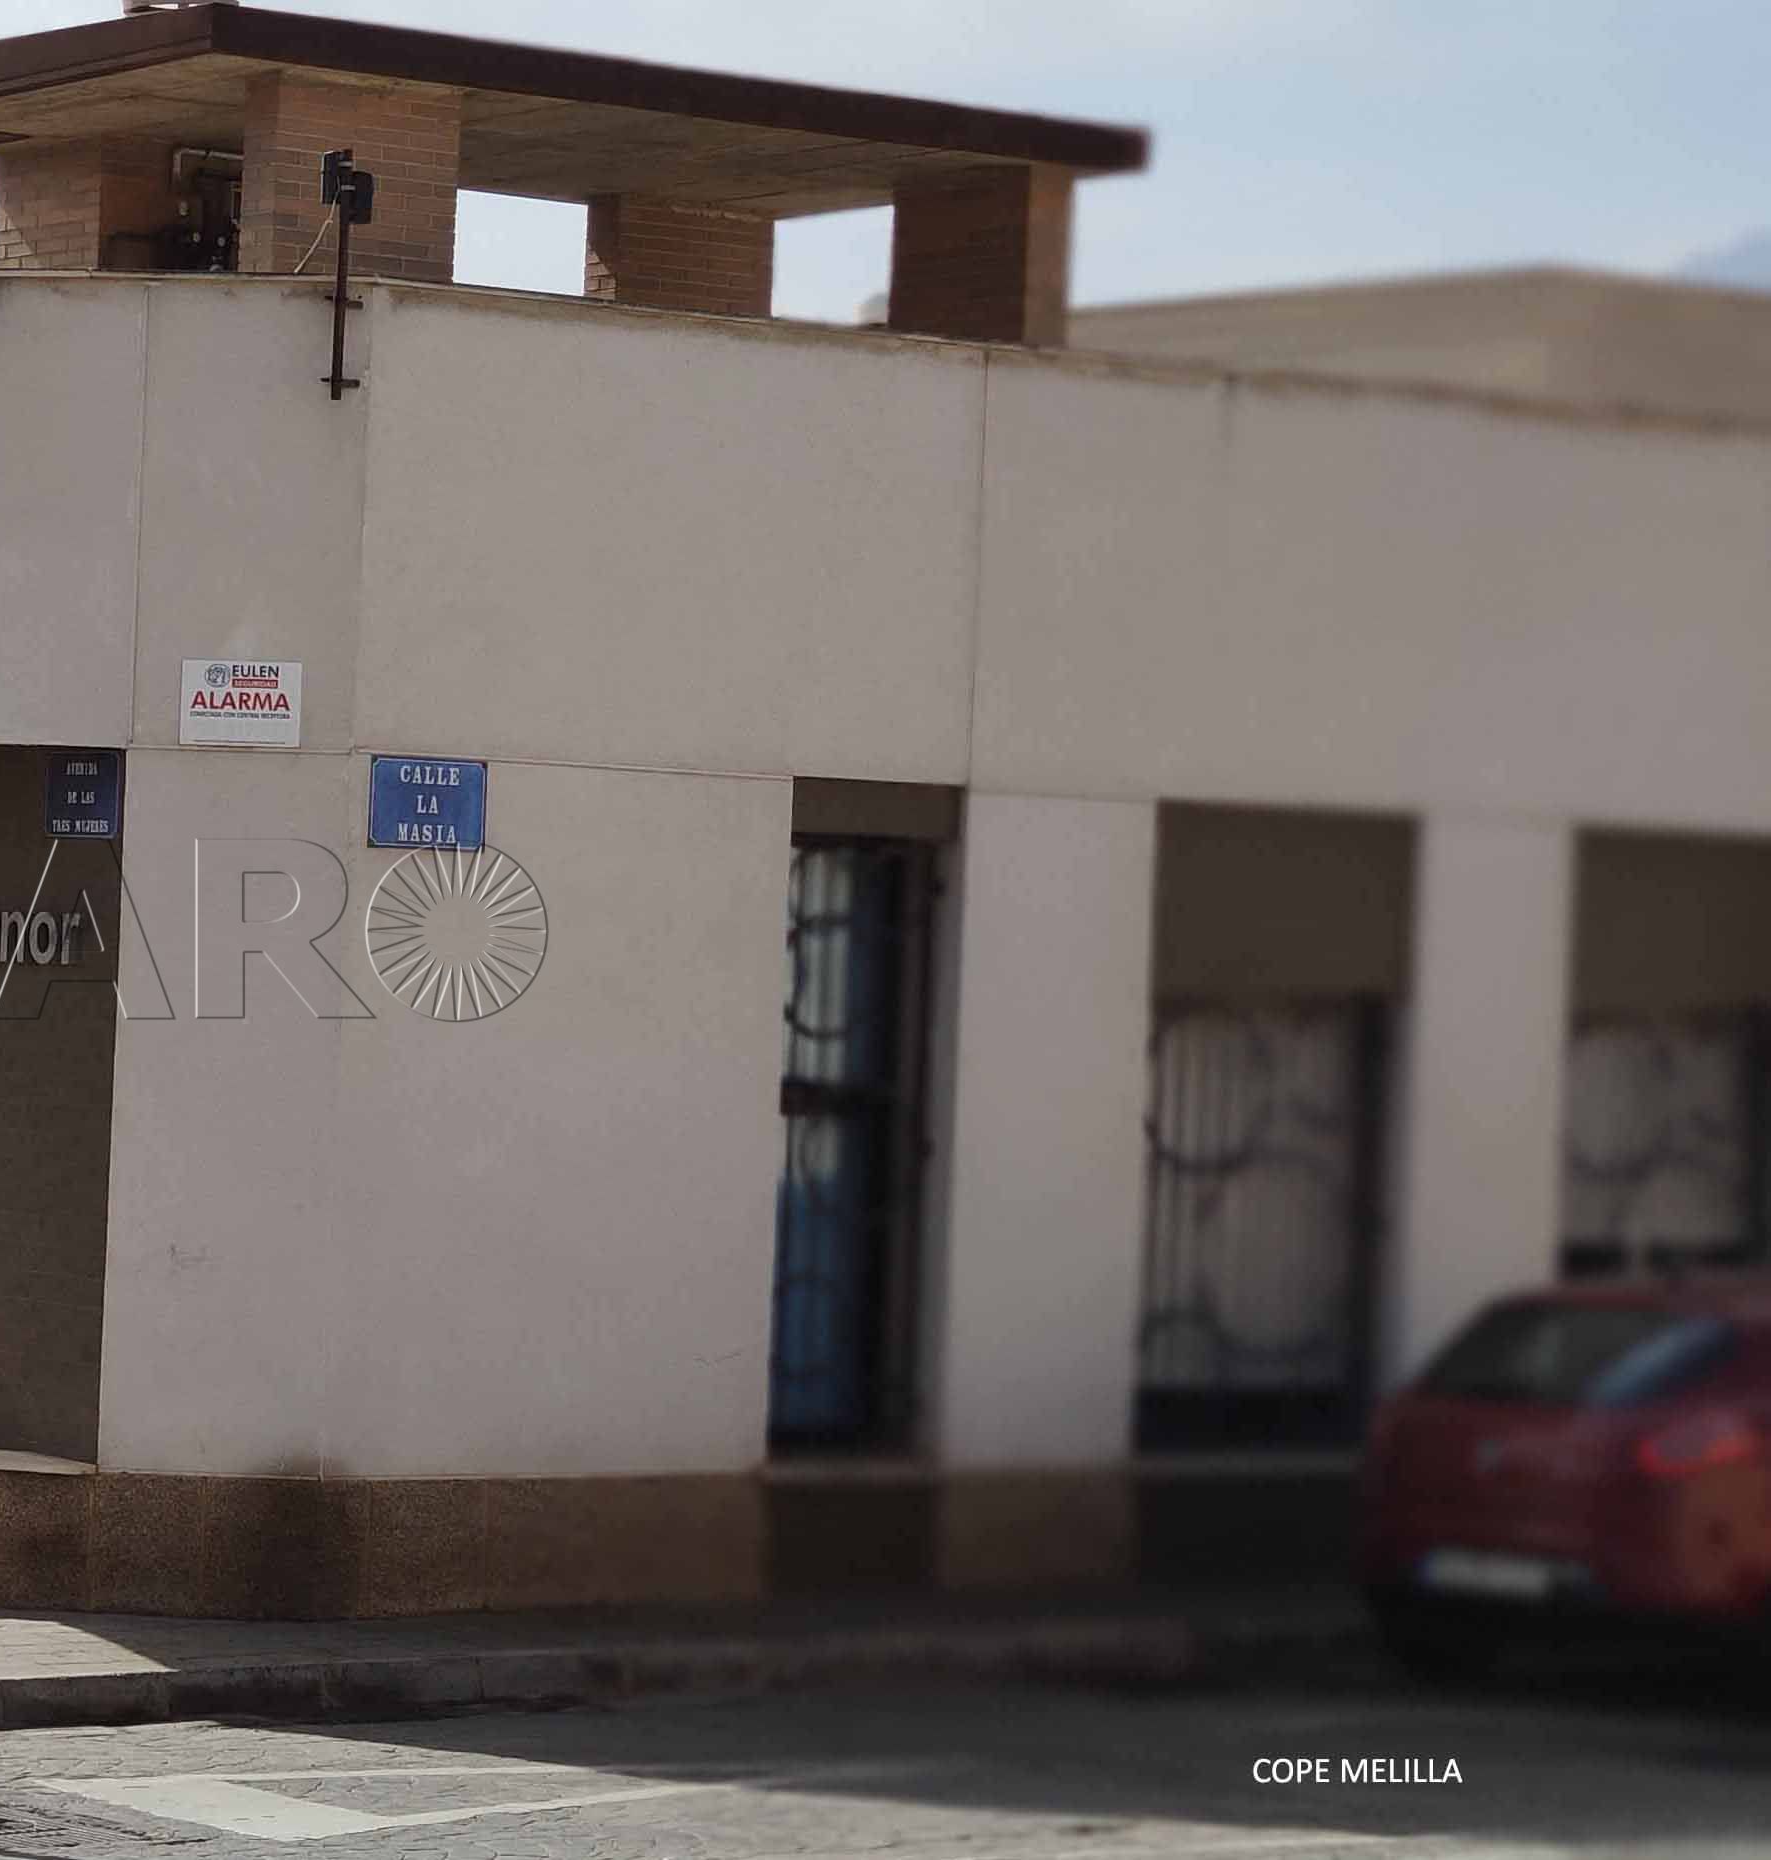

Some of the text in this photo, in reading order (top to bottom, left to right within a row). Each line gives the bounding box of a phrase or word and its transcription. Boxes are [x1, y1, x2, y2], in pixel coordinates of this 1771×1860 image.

[232, 665, 279, 678] EULEN
[190, 690, 291, 711] ALARMA
[400, 765, 460, 786] CALLE
[81, 791, 95, 804] LAS
[417, 795, 438, 814] LA
[398, 823, 457, 844] MASIA
